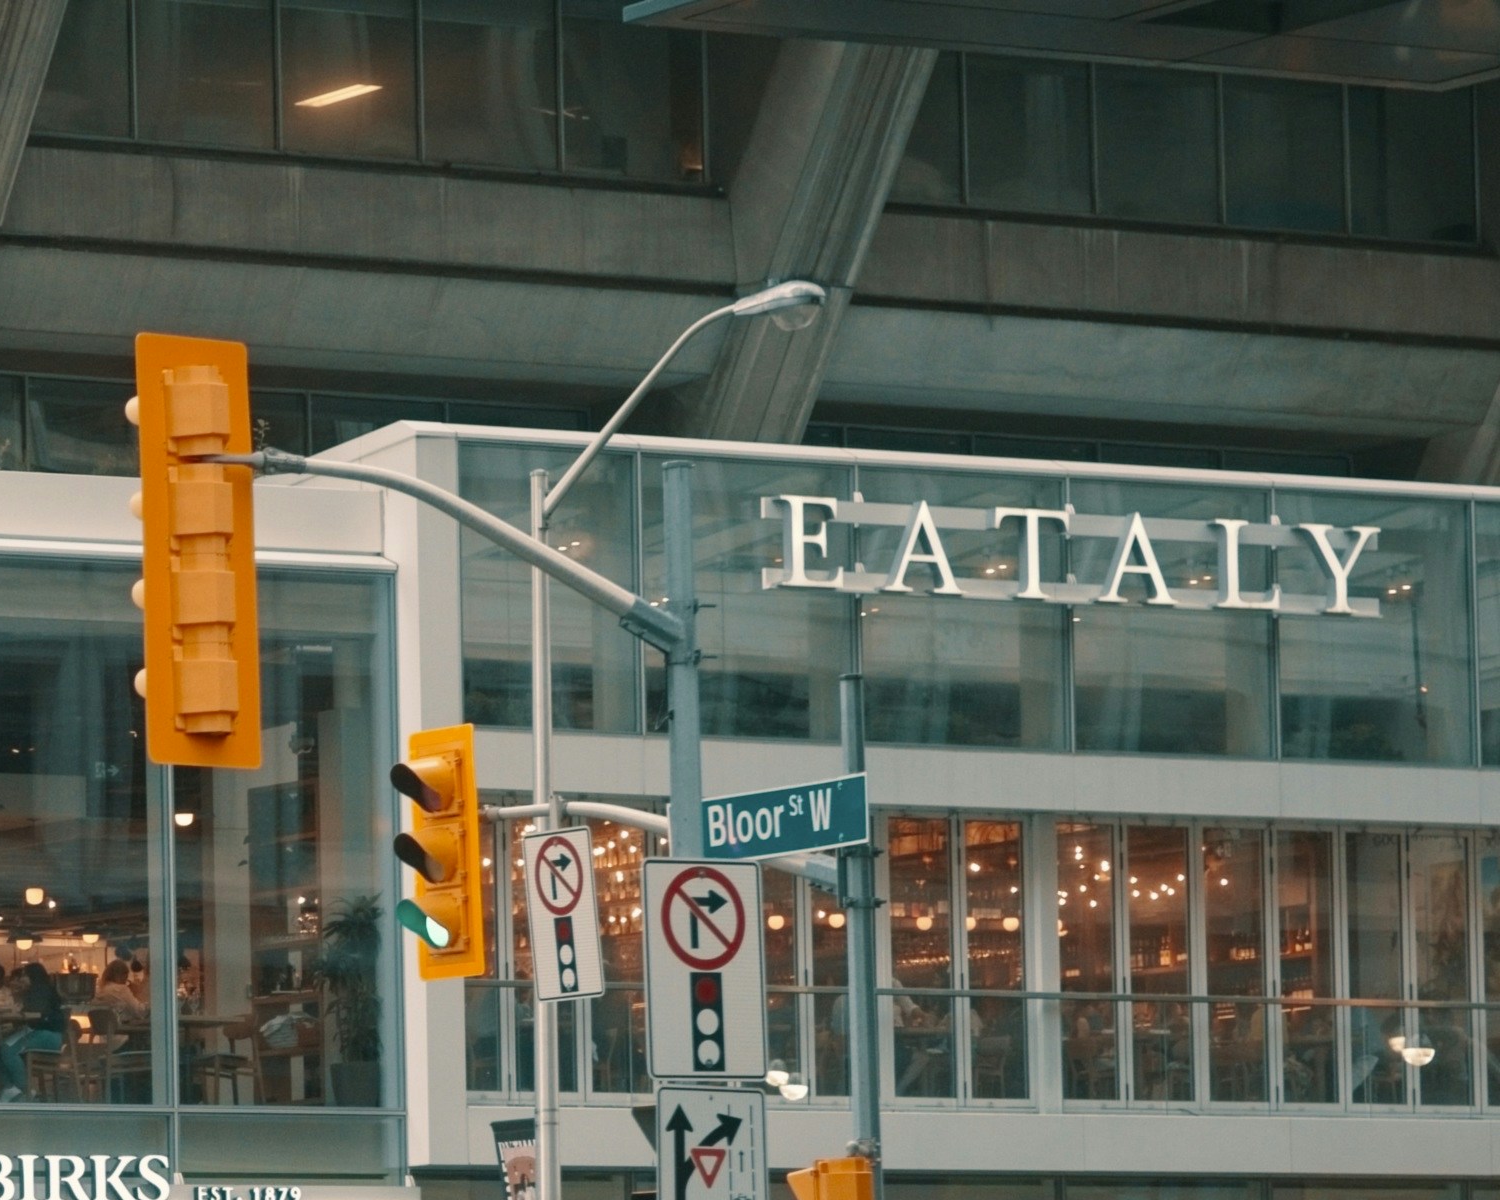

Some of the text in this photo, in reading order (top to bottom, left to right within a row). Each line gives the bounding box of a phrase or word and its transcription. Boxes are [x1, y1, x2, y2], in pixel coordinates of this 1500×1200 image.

[780, 494, 1381, 614] EATALY
[707, 787, 832, 848] Bloor St W
